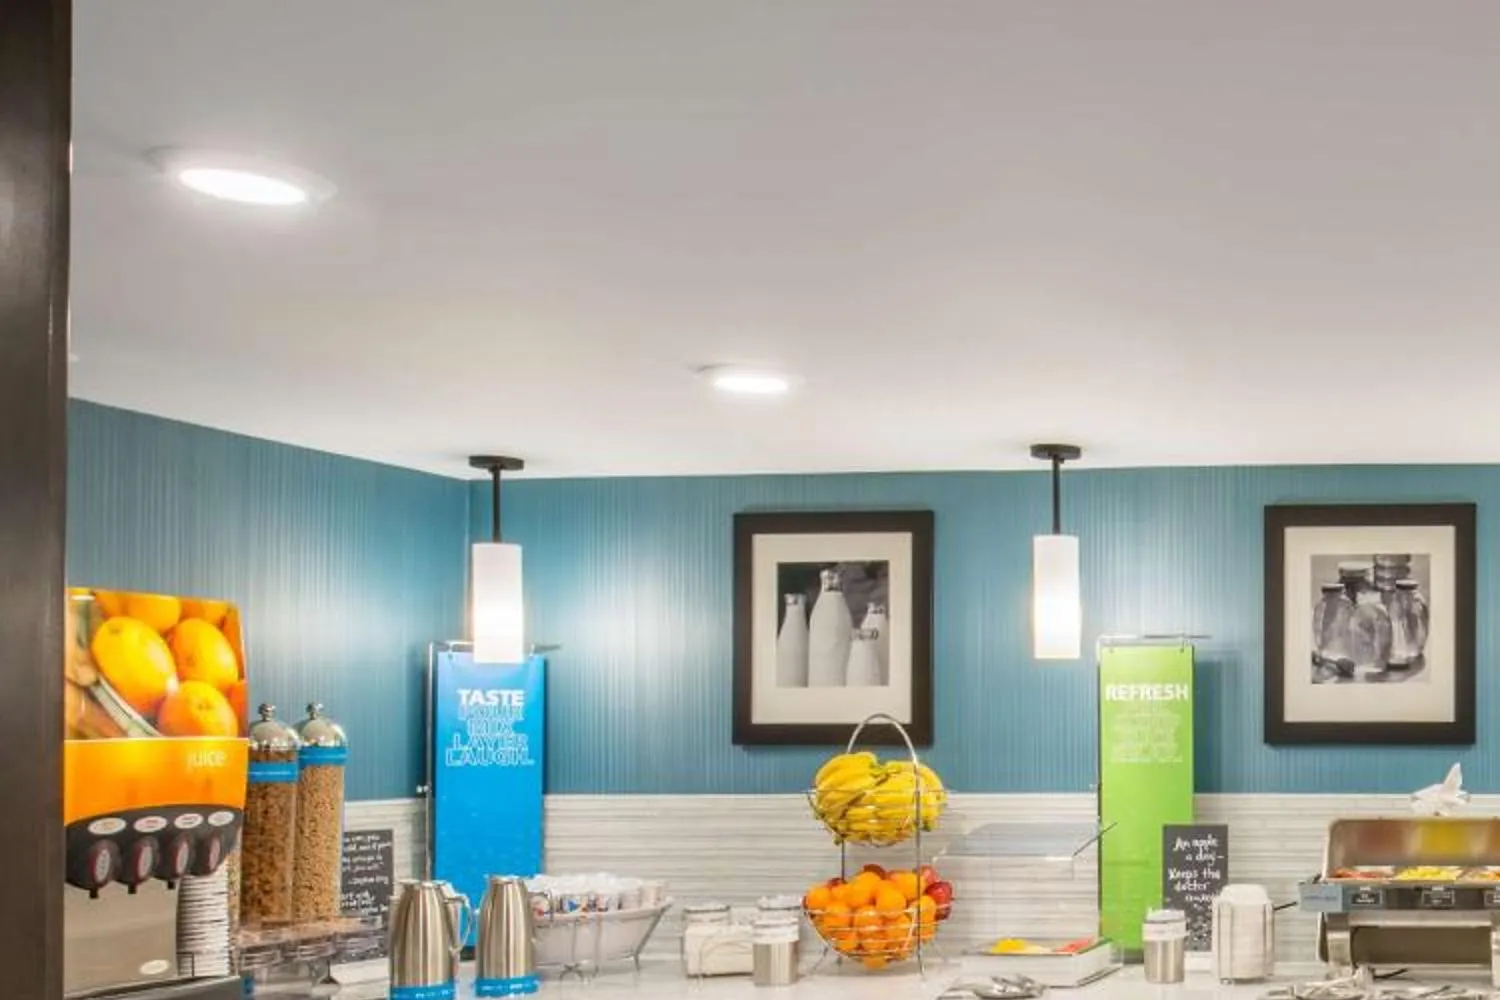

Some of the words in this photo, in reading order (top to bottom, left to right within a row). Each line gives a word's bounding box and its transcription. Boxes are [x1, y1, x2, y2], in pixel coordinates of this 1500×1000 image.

[456, 689, 525, 706] TASTE
[1105, 683, 1189, 701] REFRESH
[1172, 837, 1191, 852] An
[1185, 853, 1193, 861] a
[1202, 867, 1221, 880] the
[1173, 880, 1211, 892] doctor
